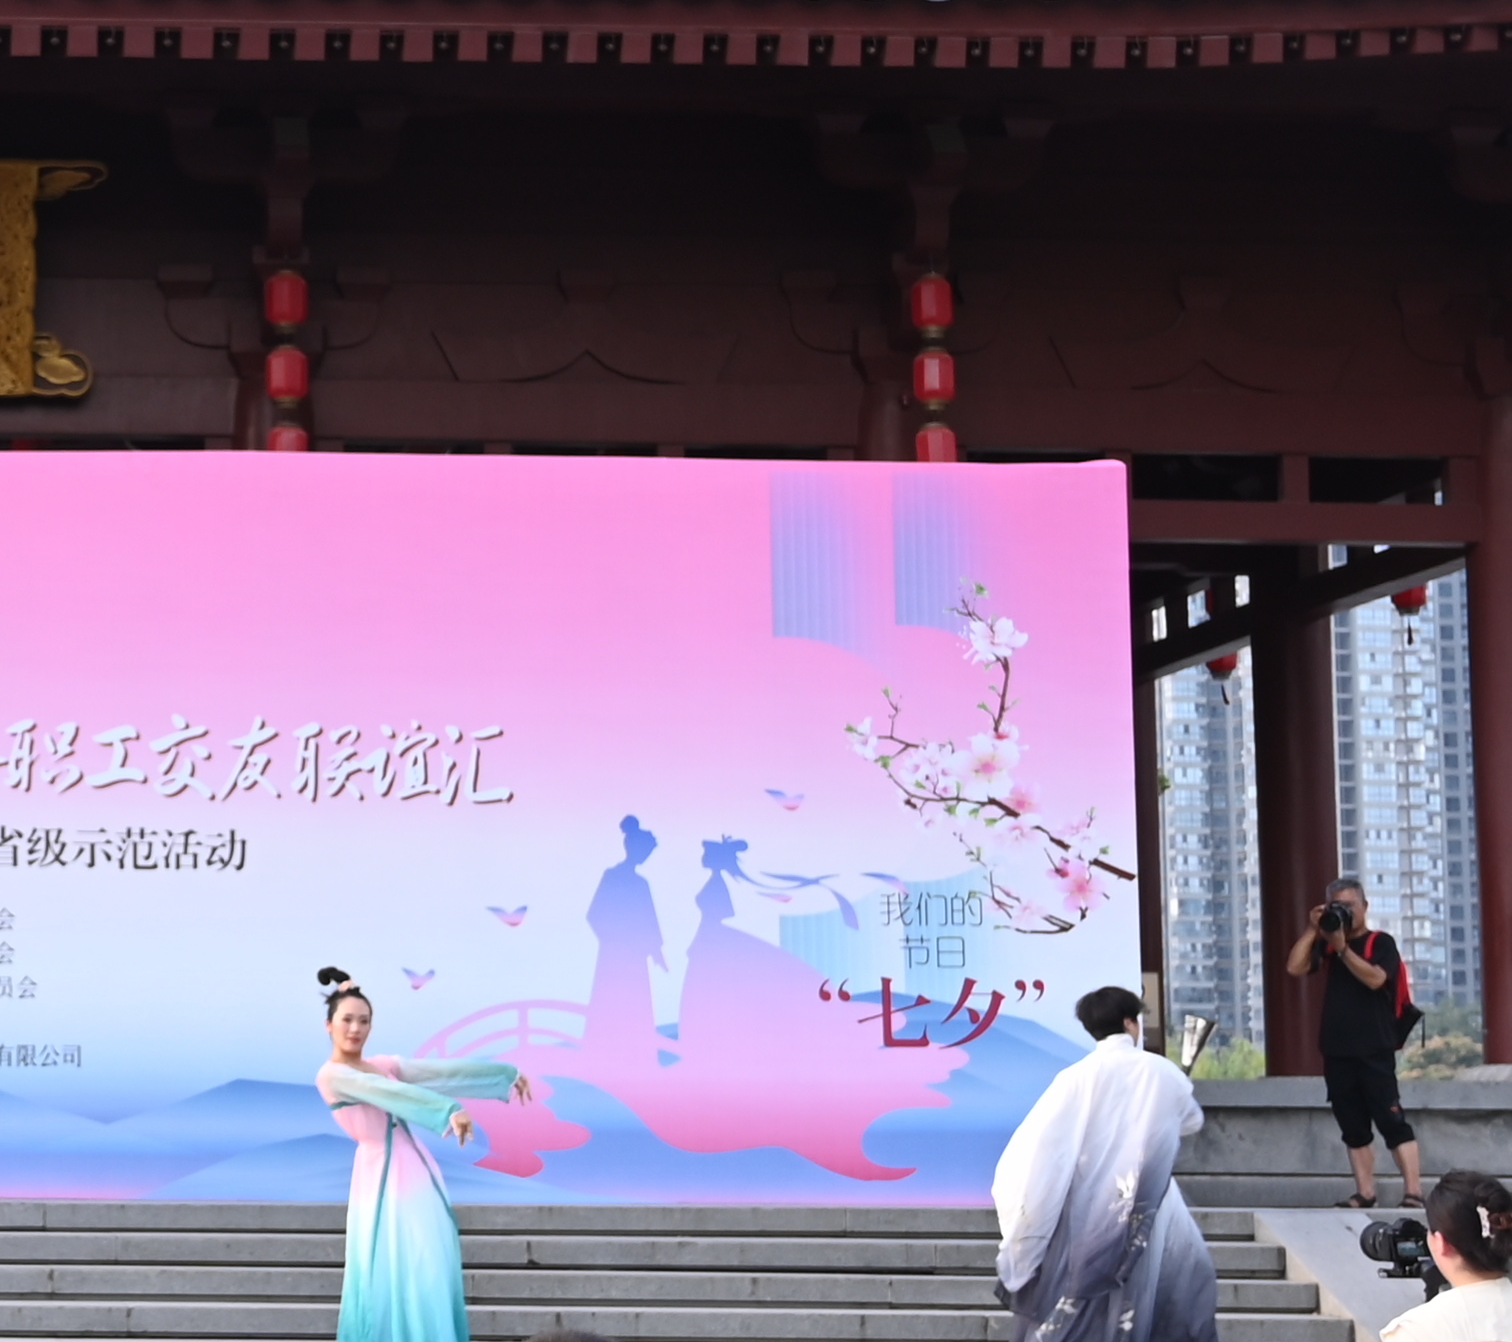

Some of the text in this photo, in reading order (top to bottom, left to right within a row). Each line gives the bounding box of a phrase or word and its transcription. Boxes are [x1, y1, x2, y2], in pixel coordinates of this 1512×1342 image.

[879, 892, 984, 928] 我们的
[899, 935, 967, 970] 节日
